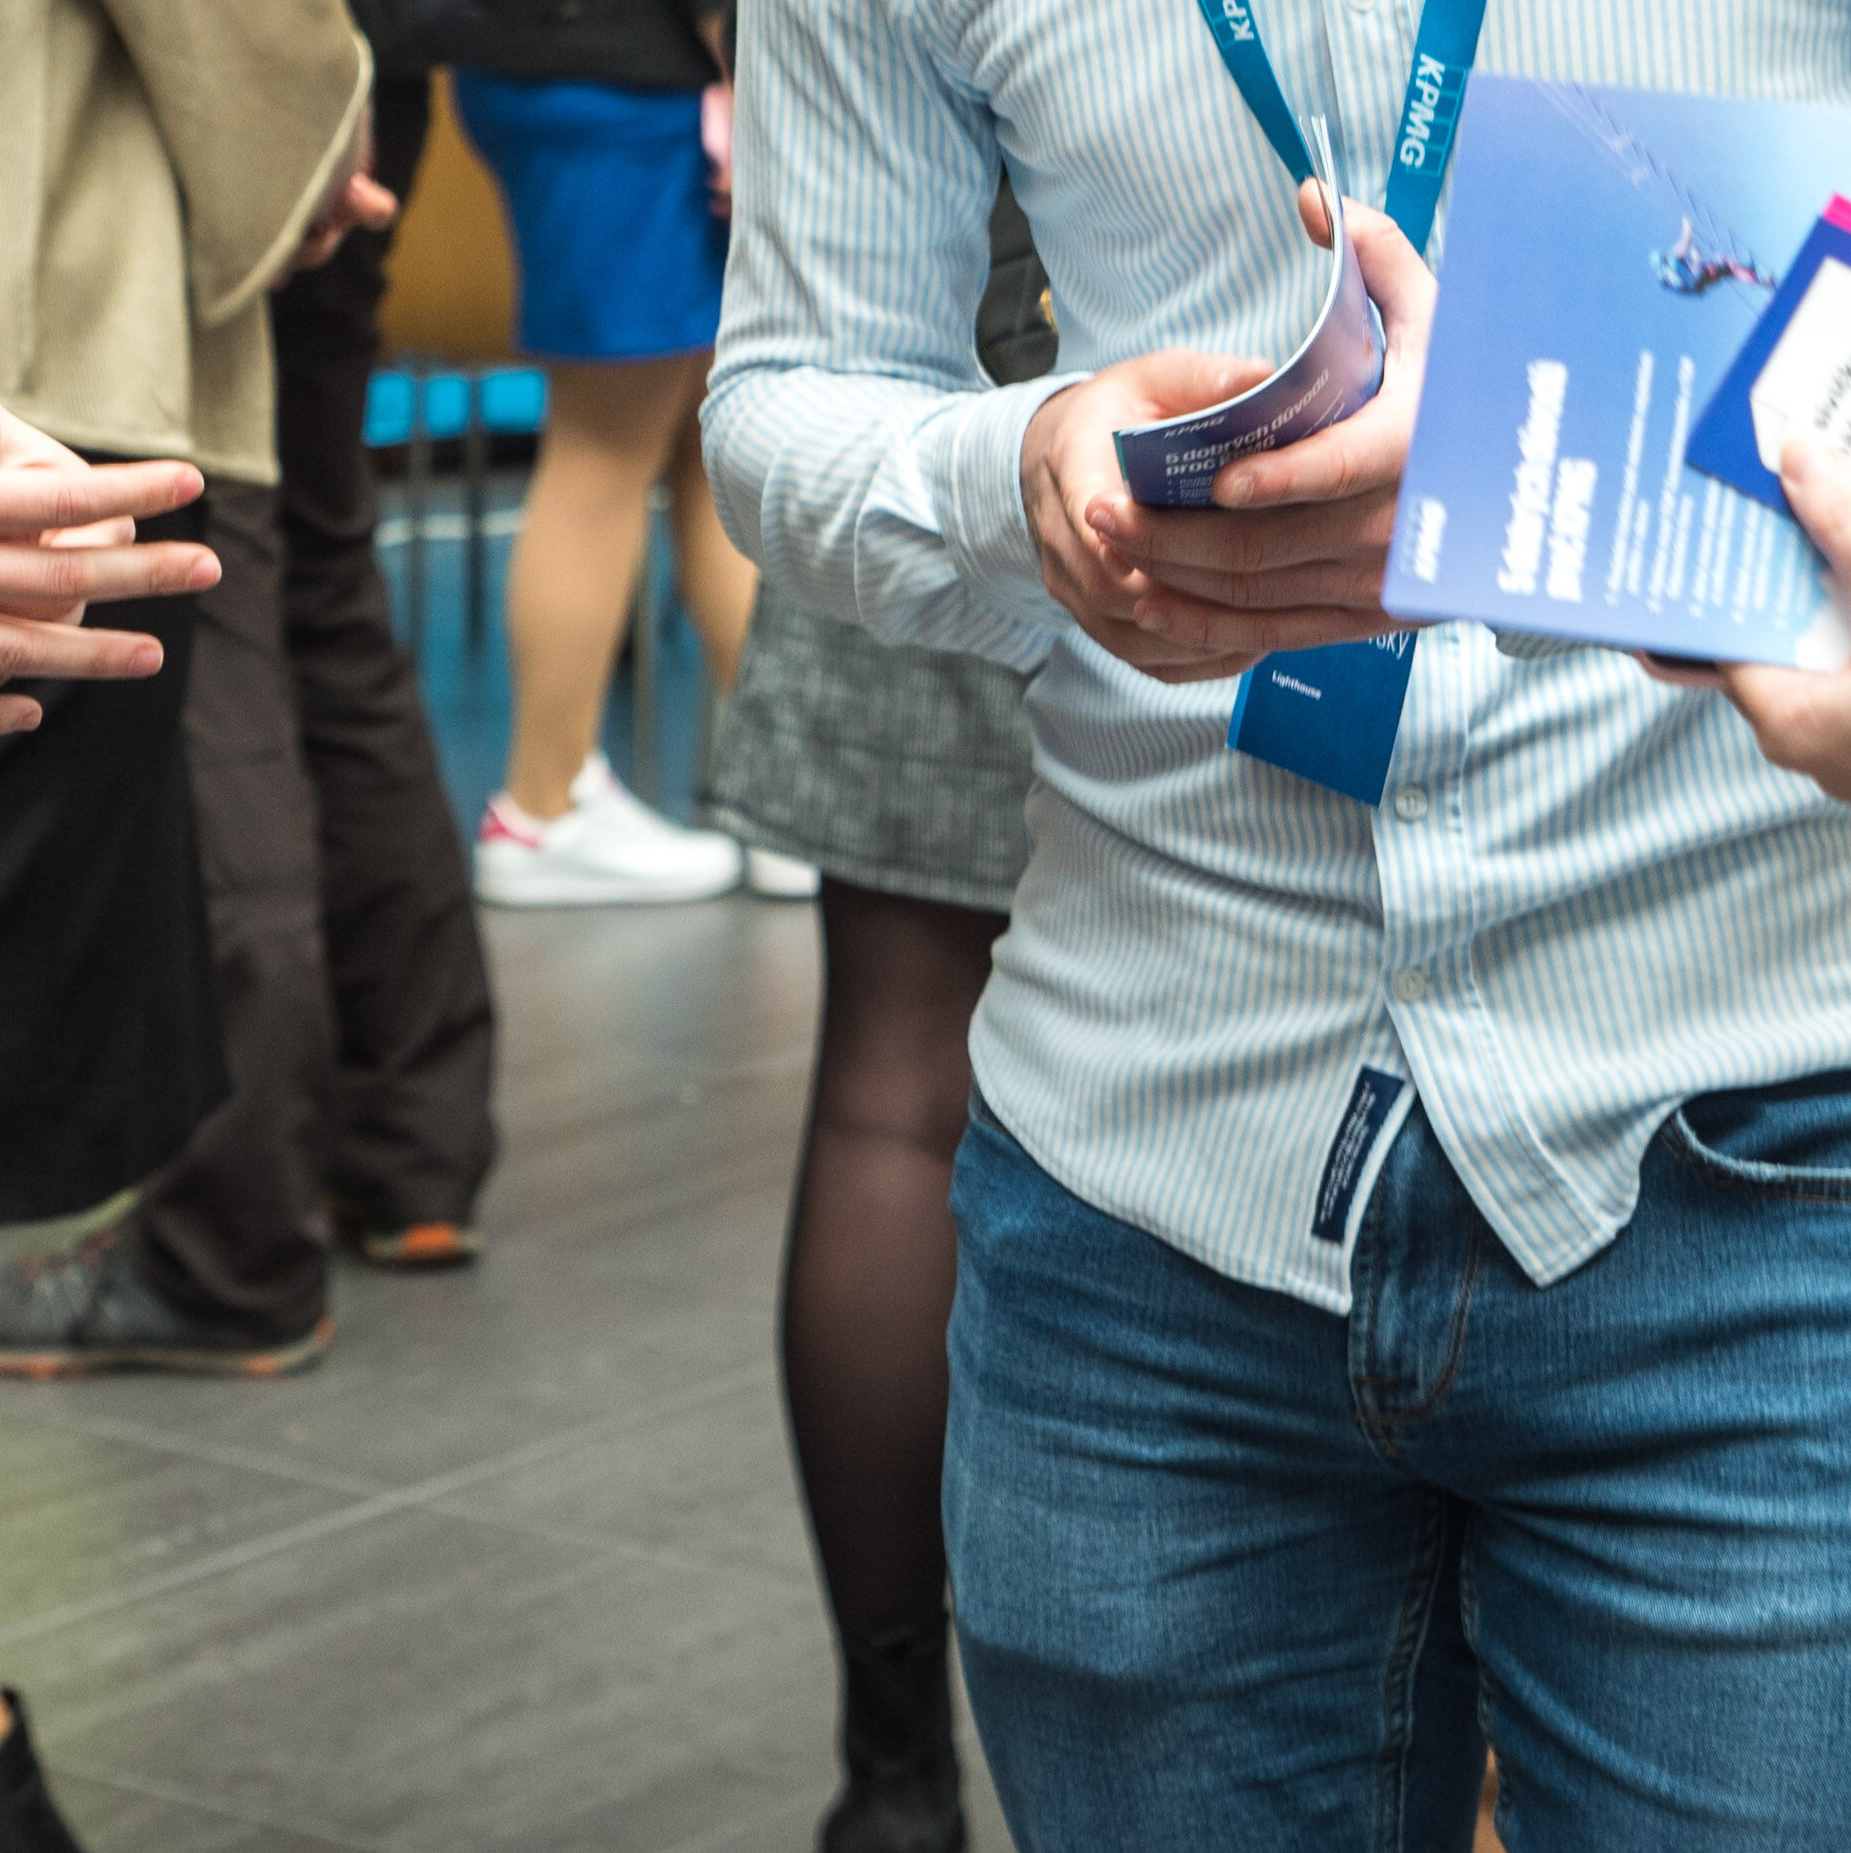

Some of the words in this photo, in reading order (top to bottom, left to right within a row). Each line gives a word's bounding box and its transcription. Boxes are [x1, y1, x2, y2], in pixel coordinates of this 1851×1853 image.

[1400, 52, 1446, 169] KPMG
[1163, 414, 1227, 439] KPMG
[1271, 669, 1322, 701] Lighthouse
